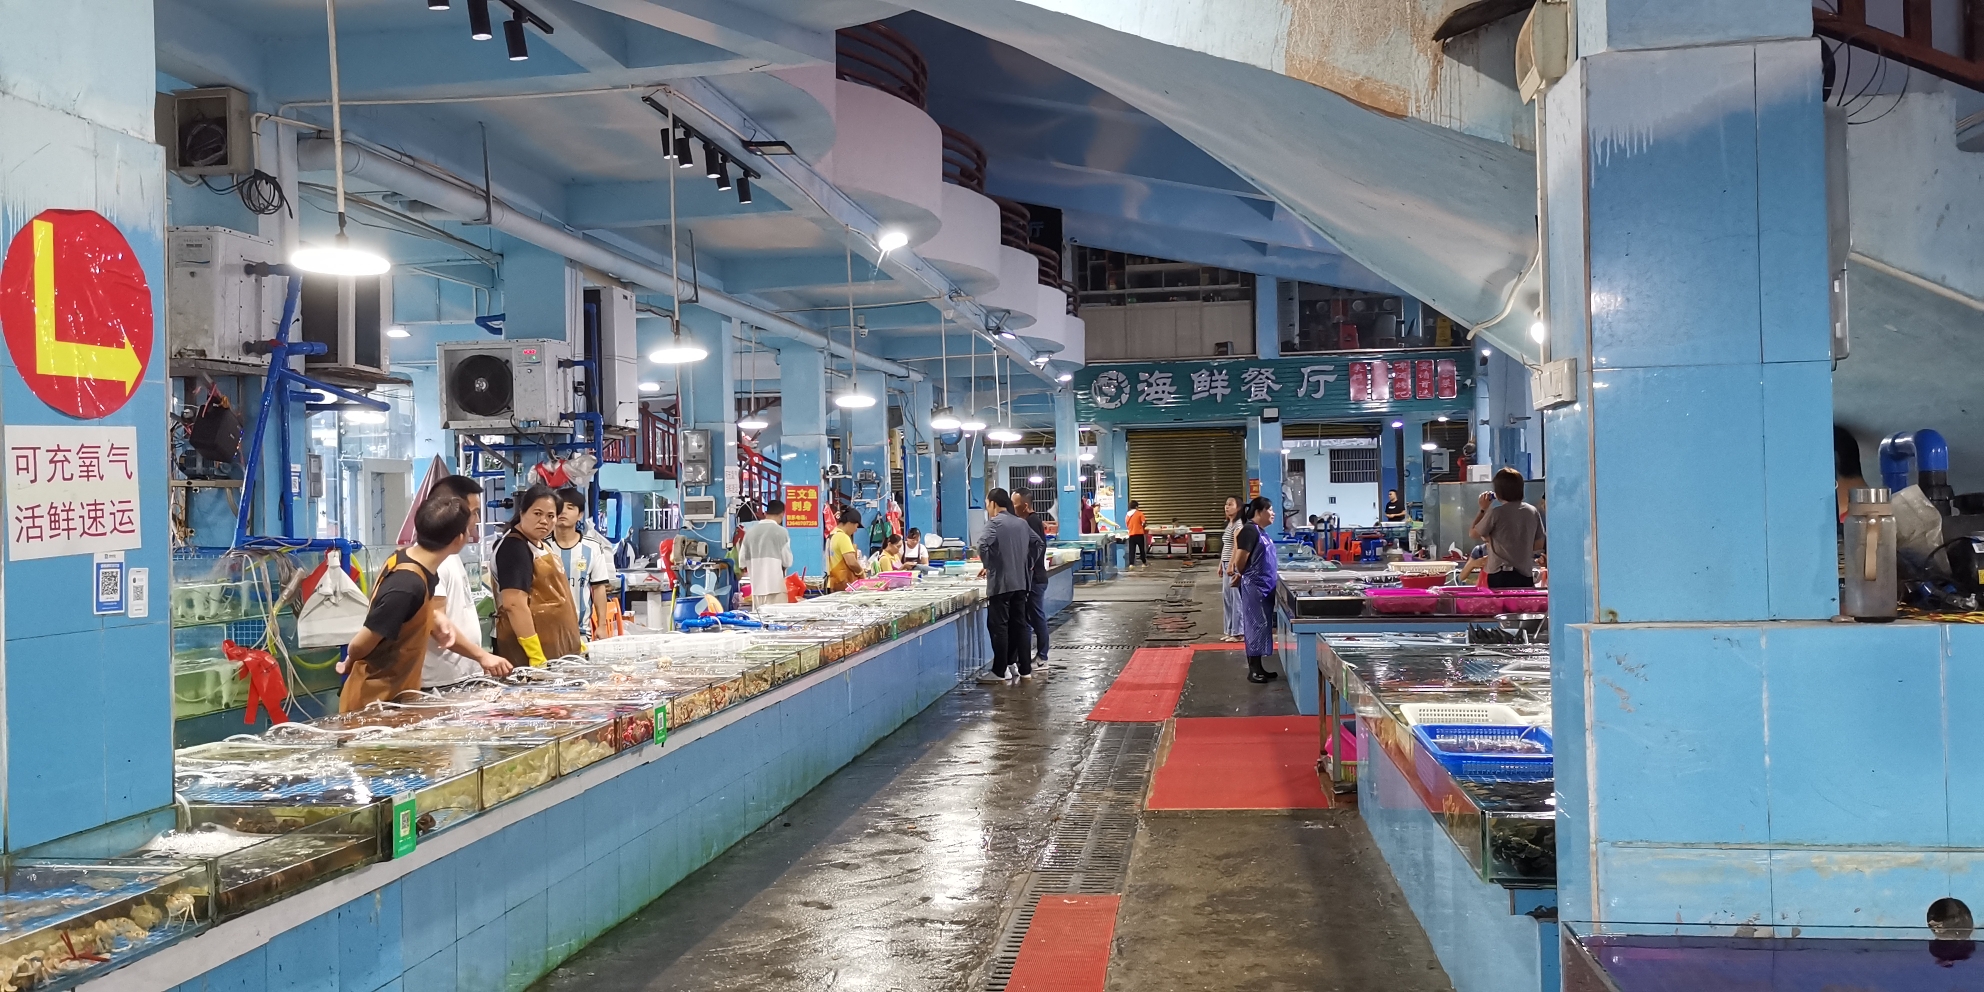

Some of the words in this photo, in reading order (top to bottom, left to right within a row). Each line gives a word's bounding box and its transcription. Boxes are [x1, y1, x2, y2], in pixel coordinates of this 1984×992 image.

[1137, 365, 1337, 405] 海鲜餐厅
[11, 442, 134, 484] 可充氧气
[787, 489, 817, 499] 三文鱼
[791, 501, 812, 511] 刺身
[15, 498, 136, 544] 活鲜速运
